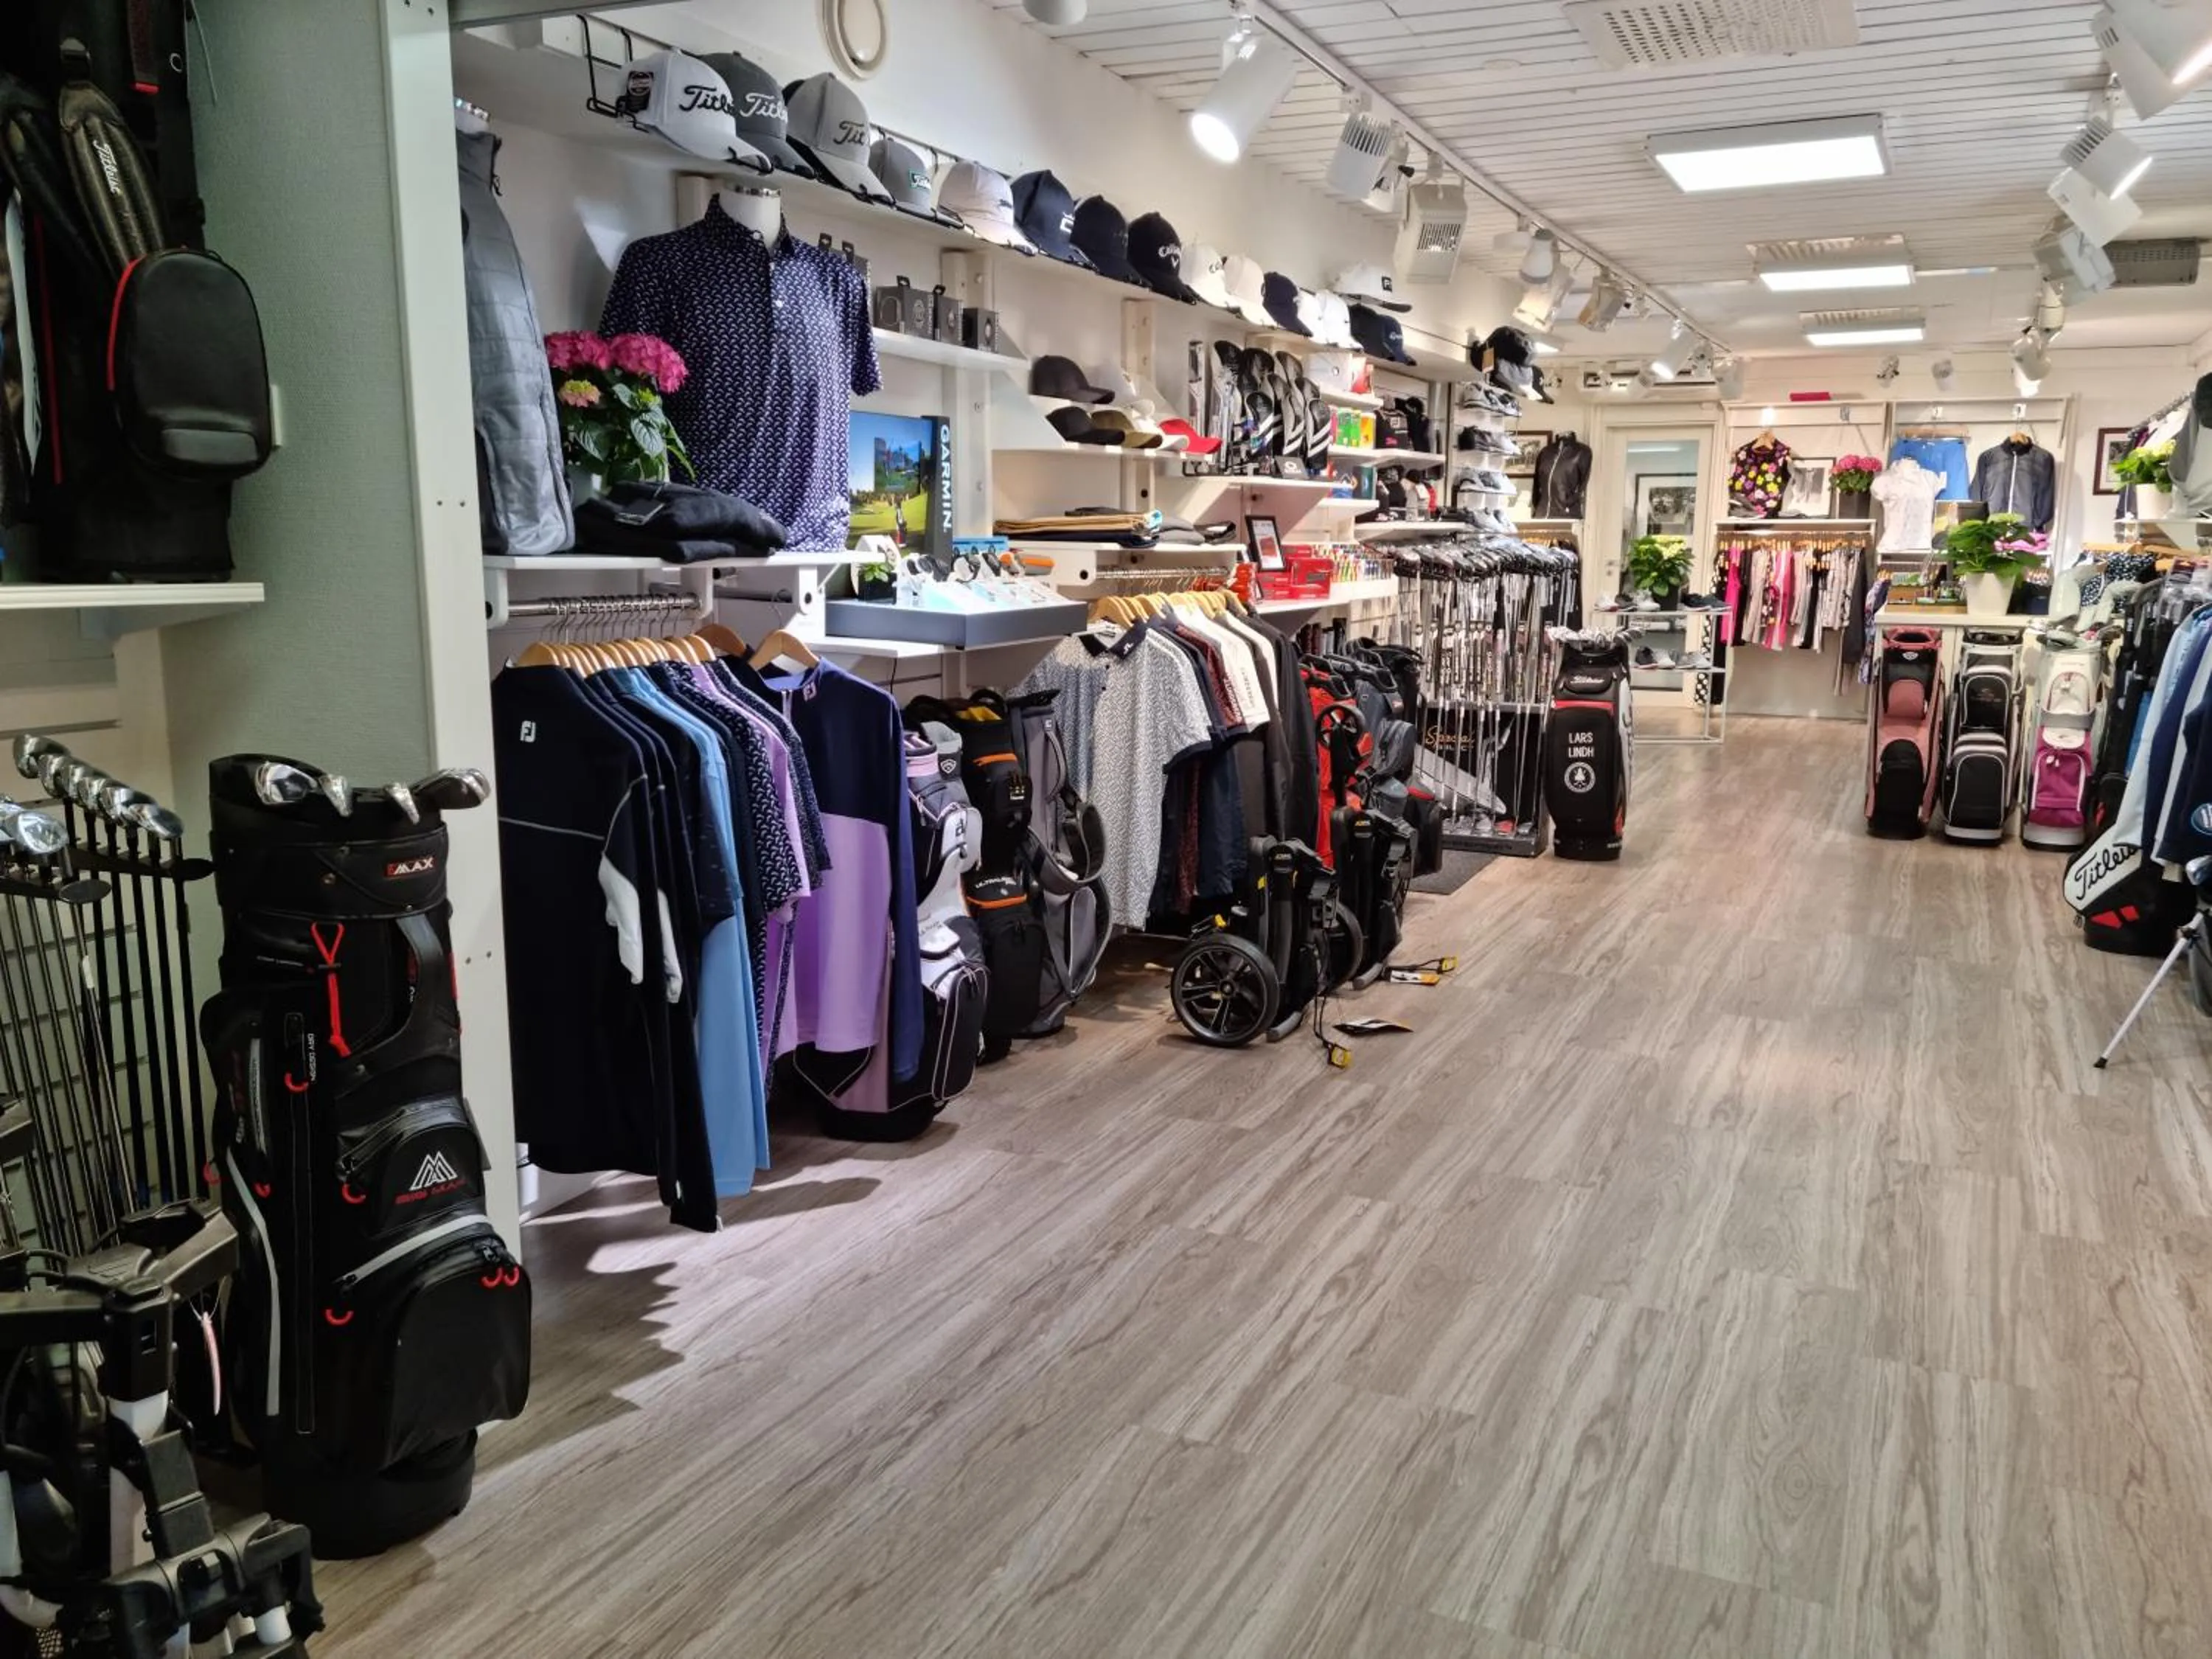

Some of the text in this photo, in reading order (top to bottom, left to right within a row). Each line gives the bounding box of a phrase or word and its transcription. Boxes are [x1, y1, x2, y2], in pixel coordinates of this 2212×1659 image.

[940, 424, 952, 529] GARMIN
[1568, 732, 1593, 744] LARS
[1568, 745, 1595, 758] LINDH
